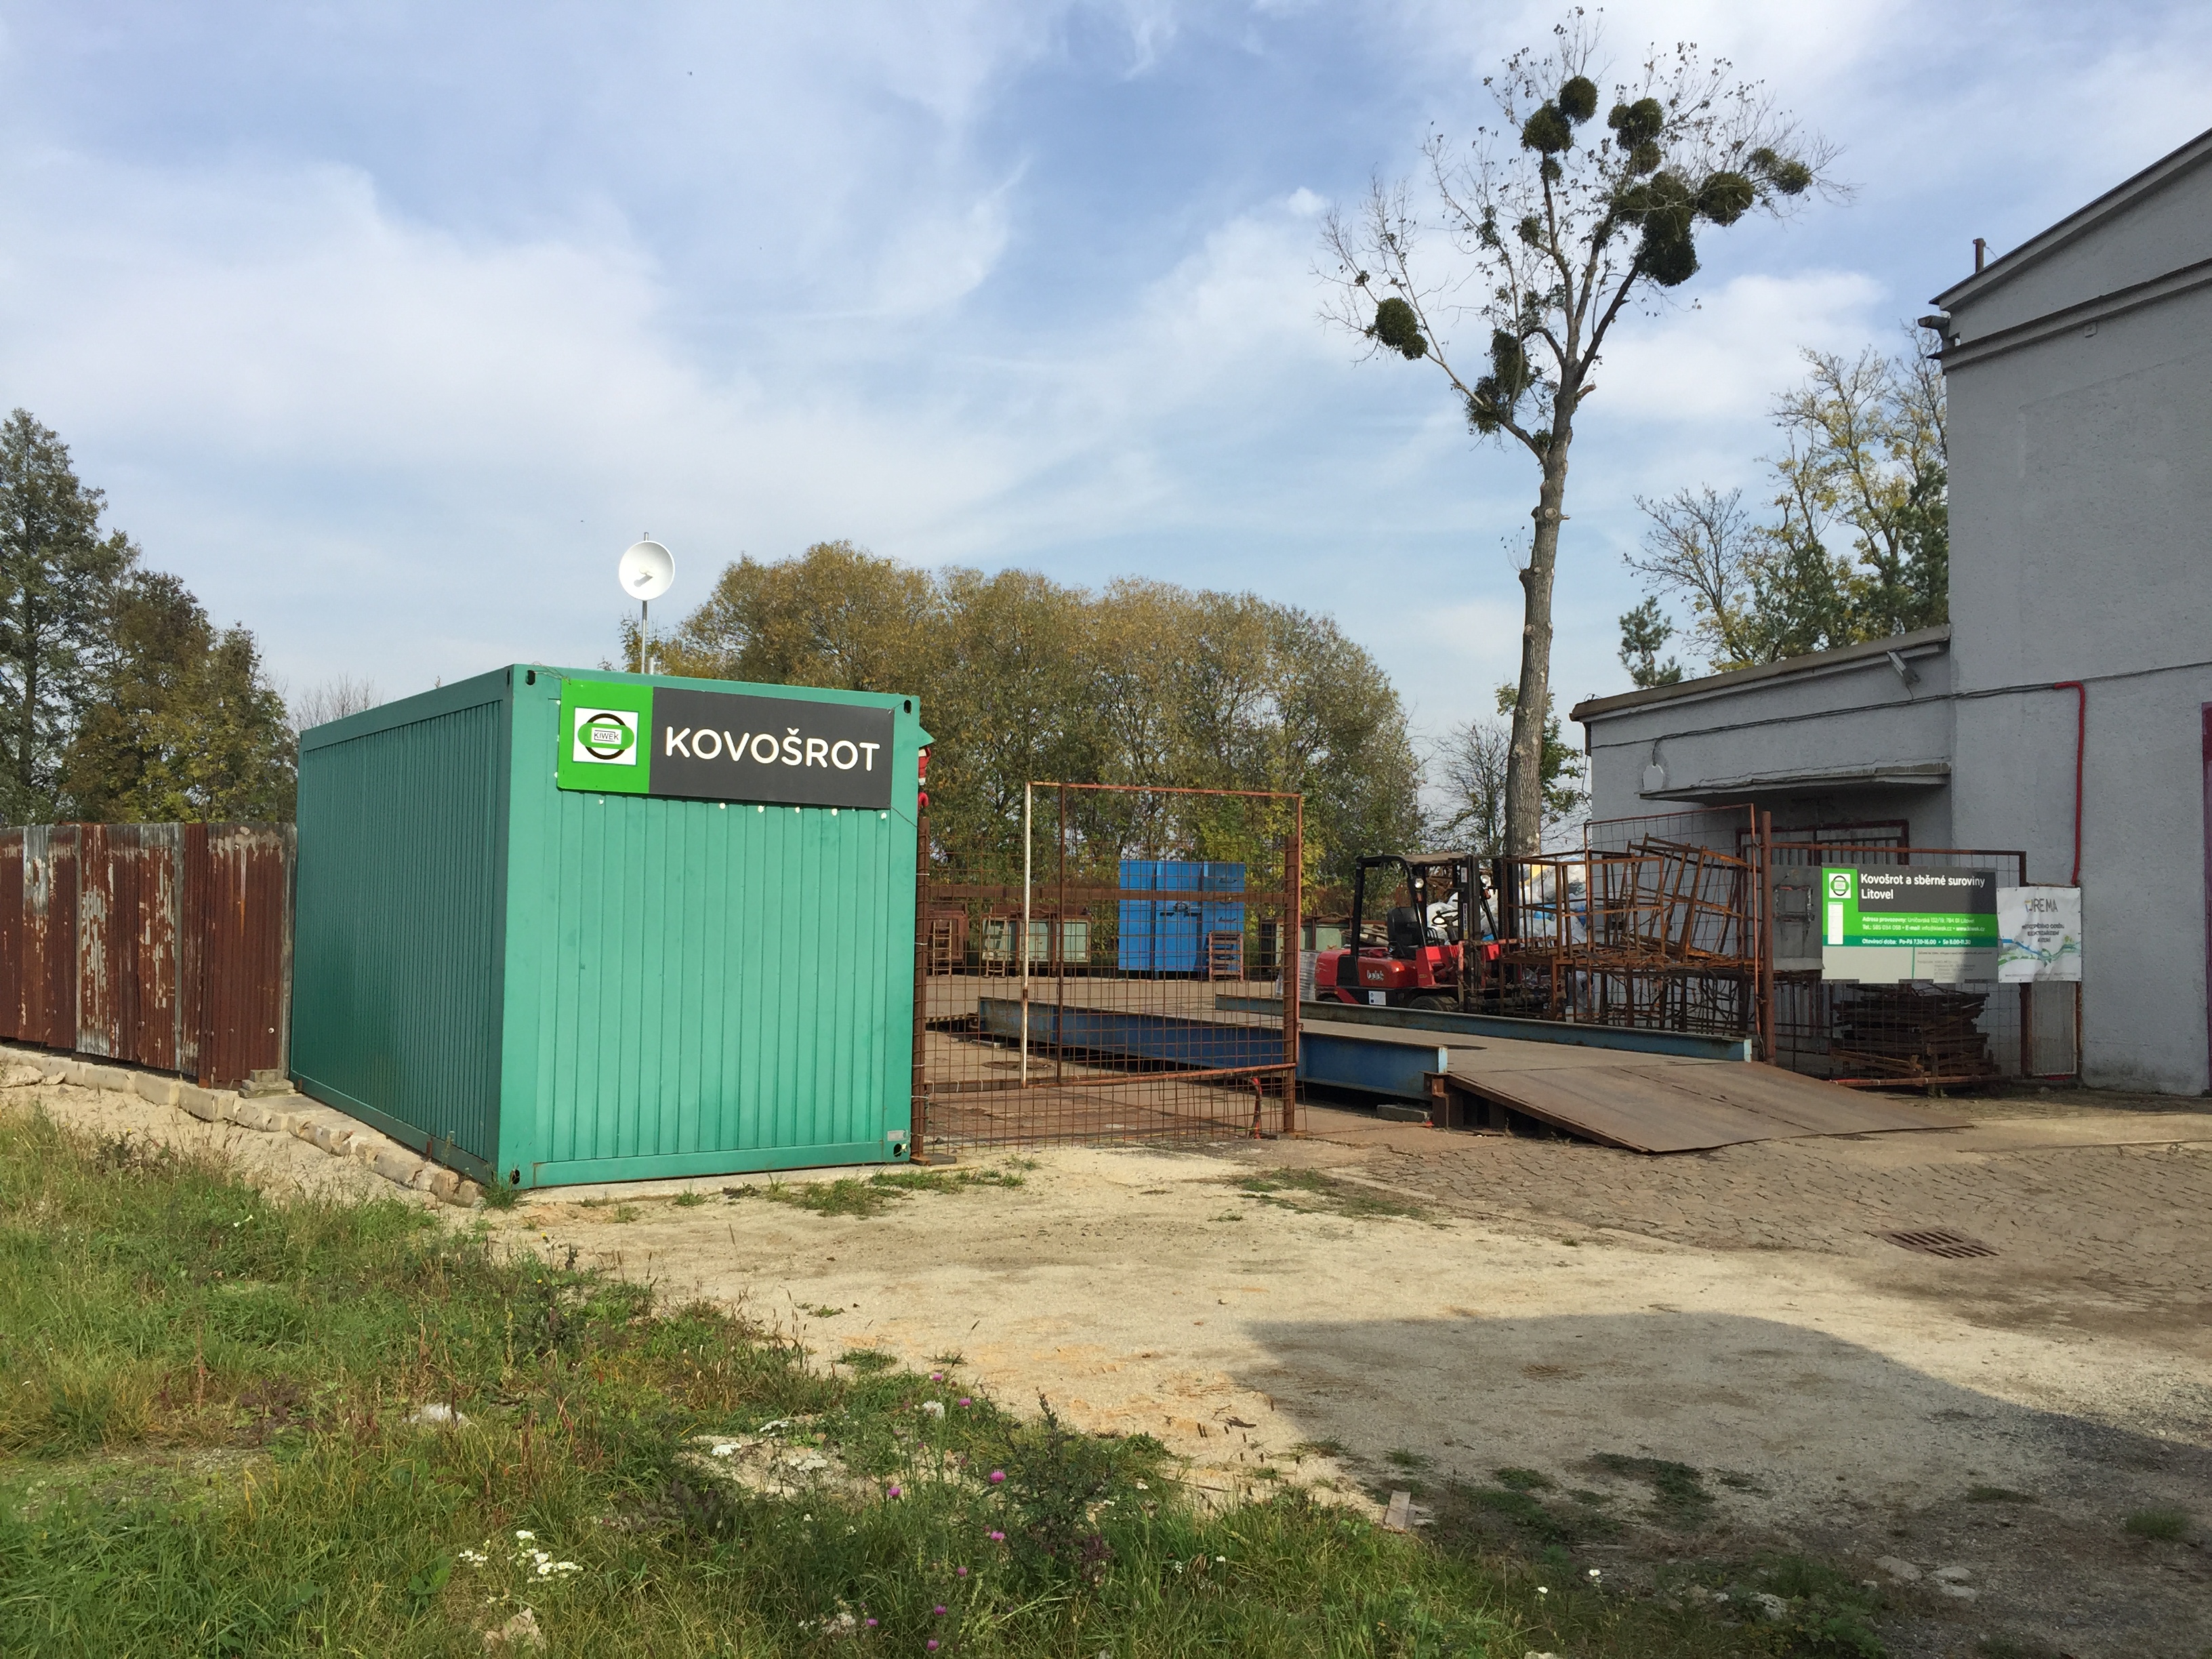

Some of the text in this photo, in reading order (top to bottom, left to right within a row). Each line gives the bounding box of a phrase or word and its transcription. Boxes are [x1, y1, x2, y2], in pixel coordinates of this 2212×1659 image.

[594, 732, 619, 741] KIWEK
[665, 726, 880, 771] KOVOŠROT
[1861, 874, 1904, 884] Kovošrot
[1914, 874, 1946, 885] sběrné
[1948, 876, 1986, 888] suroviny
[1861, 888, 1893, 899] Litovel
